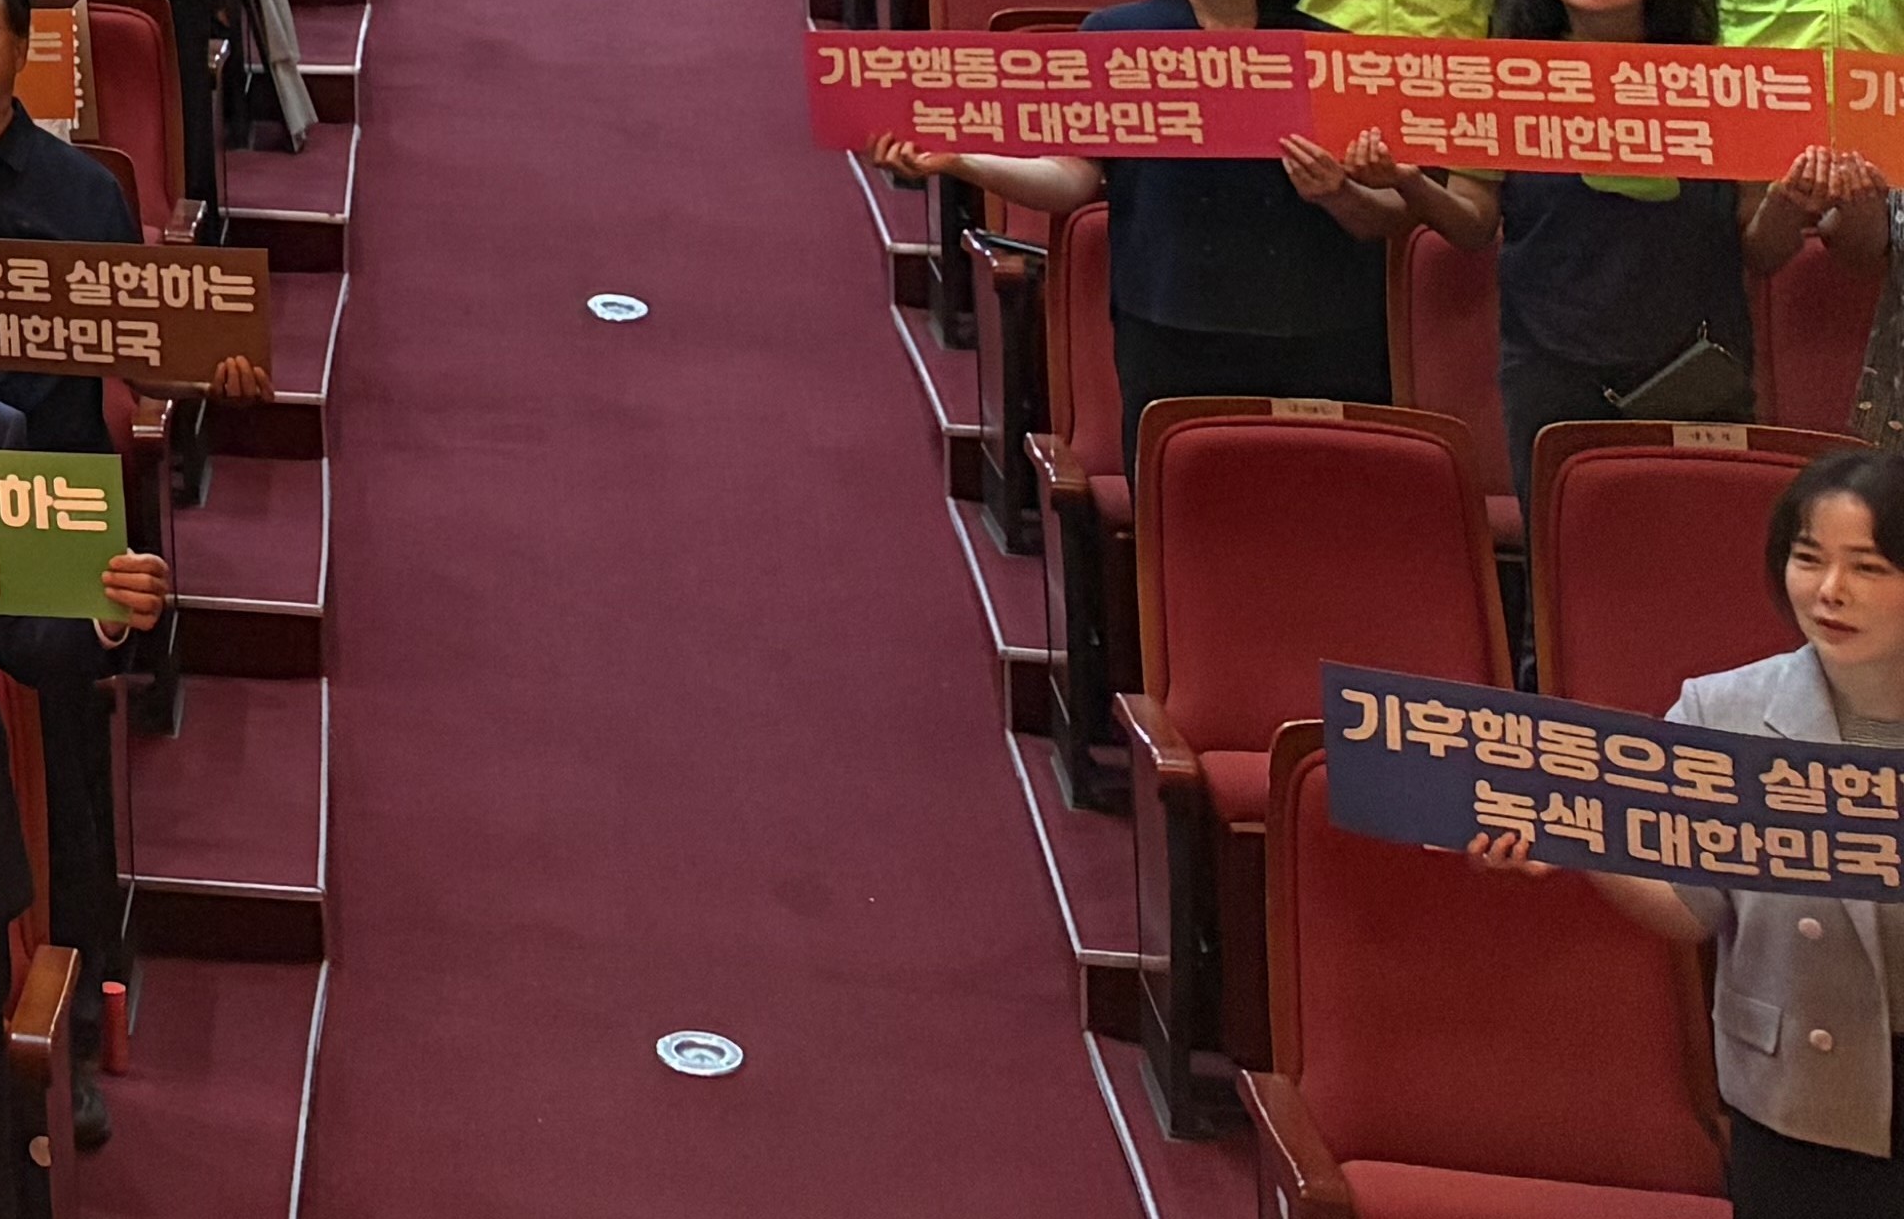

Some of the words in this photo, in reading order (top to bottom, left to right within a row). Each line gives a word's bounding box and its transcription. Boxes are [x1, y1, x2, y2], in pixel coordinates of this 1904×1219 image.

[818, 46, 1092, 89] 기후행동으로
[1105, 46, 1293, 89] 실현하는
[1305, 50, 1595, 102] 기후행동으로
[1610, 62, 1811, 110] 실현하는
[913, 100, 1004, 142] 녹색
[1018, 101, 1203, 143] 대한민국
[1400, 109, 1499, 155] 녹색
[1514, 116, 1713, 165] 대한민국
[66, 260, 255, 311] 실현하는
[1341, 689, 1738, 806] 기후행동으로
[1468, 780, 1605, 854] 녹색
[1626, 810, 1901, 886] 대한민국
